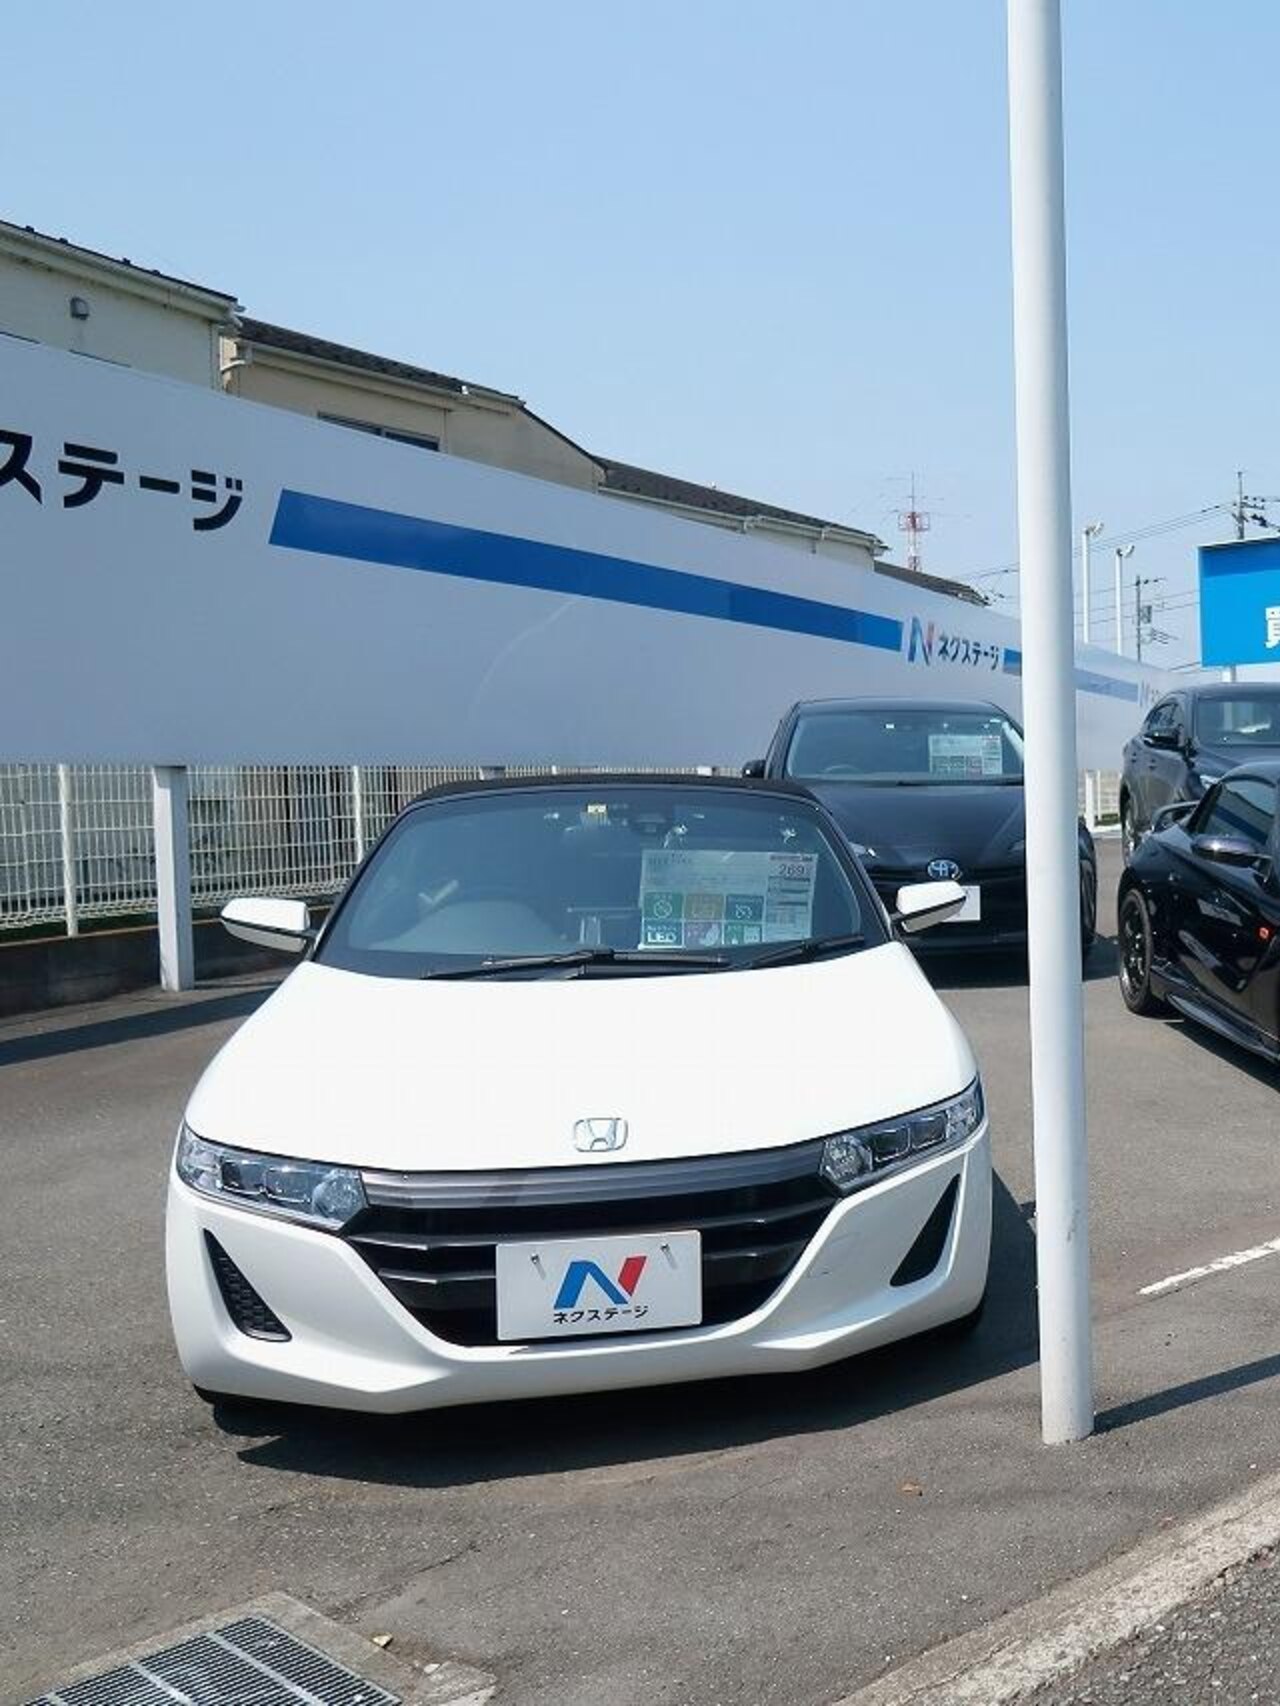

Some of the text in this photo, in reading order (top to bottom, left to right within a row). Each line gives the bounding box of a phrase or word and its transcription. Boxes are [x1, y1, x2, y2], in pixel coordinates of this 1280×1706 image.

[938, 634, 999, 670] ネクステージ
[553, 1305, 649, 1325] ネクステージ
